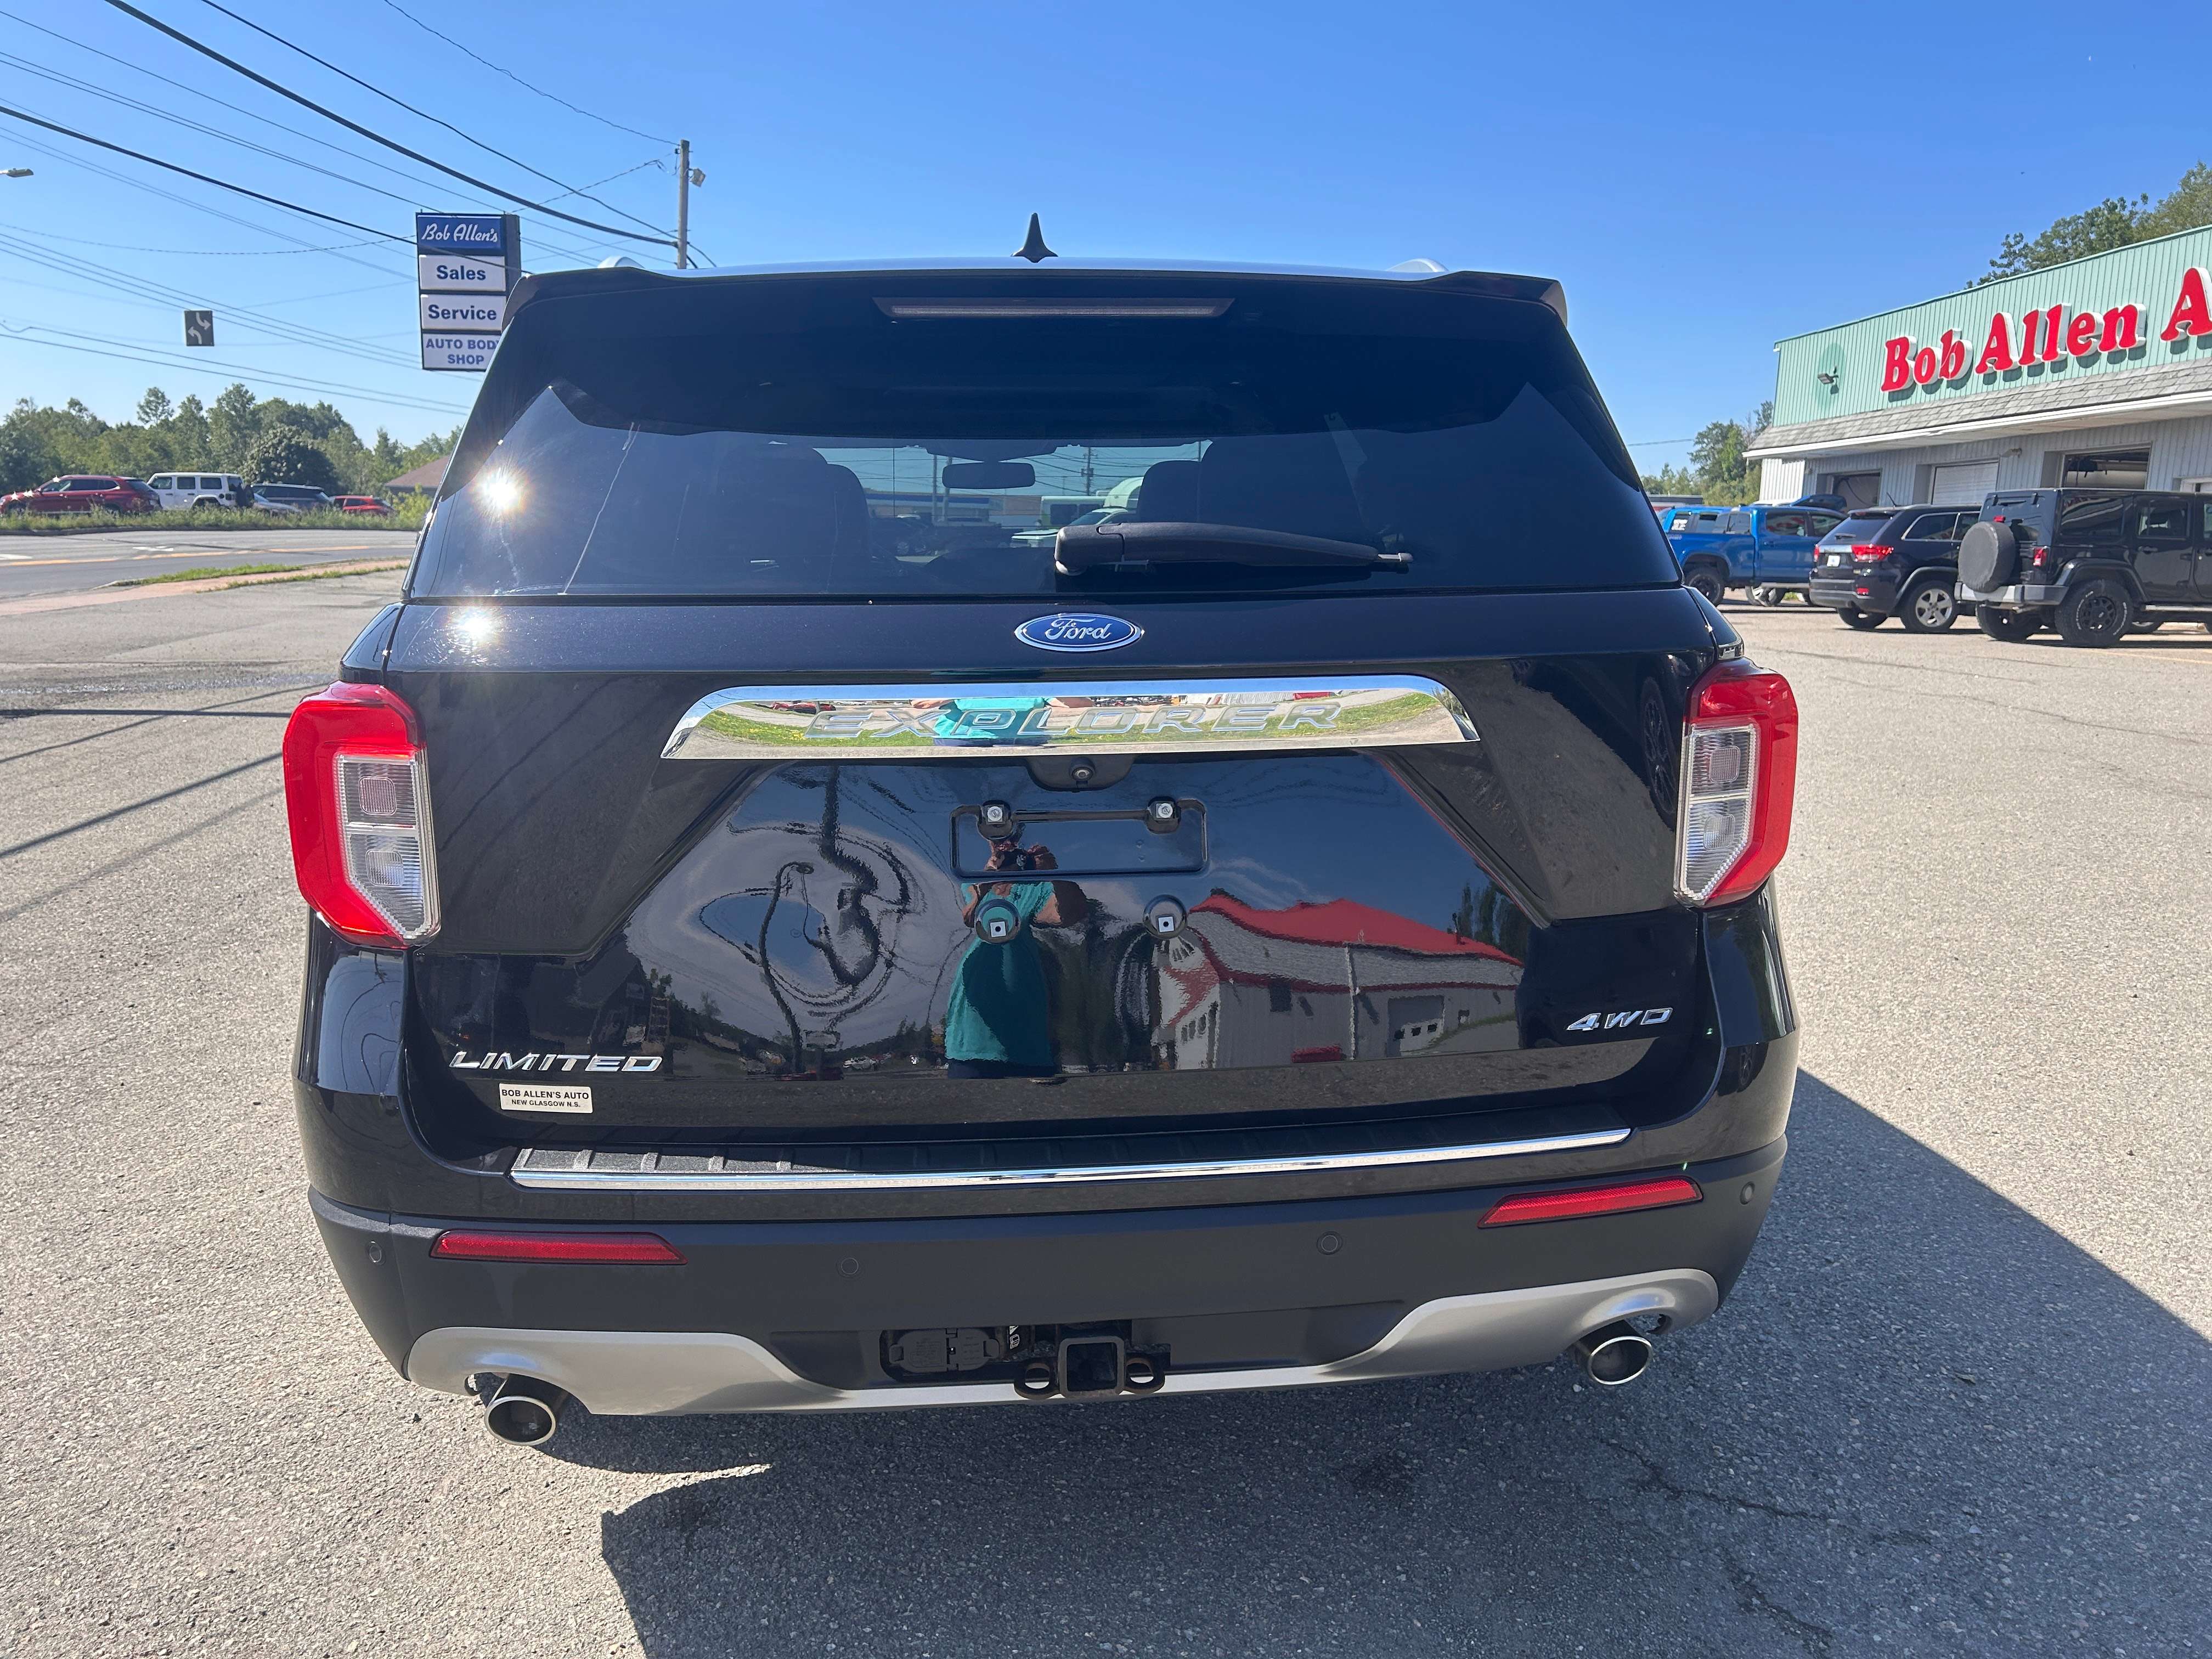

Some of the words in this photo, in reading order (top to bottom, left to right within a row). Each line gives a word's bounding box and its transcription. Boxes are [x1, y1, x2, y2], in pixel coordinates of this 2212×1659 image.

[421, 223, 450, 240] Bob
[453, 224, 498, 242] Allen's
[436, 265, 486, 280] Sales
[428, 304, 496, 320] Service
[426, 338, 463, 349] AUTO
[1881, 328, 1972, 392] Bob
[1975, 303, 2146, 374] Allen
[447, 354, 484, 365] SHOP
[1045, 618, 1113, 640] Ford
[804, 701, 1342, 737] EXPLORER
[1566, 1007, 1673, 1031] 4WD
[448, 1051, 663, 1072] LIMITED
[523, 1090, 561, 1098] ALLEN'S
